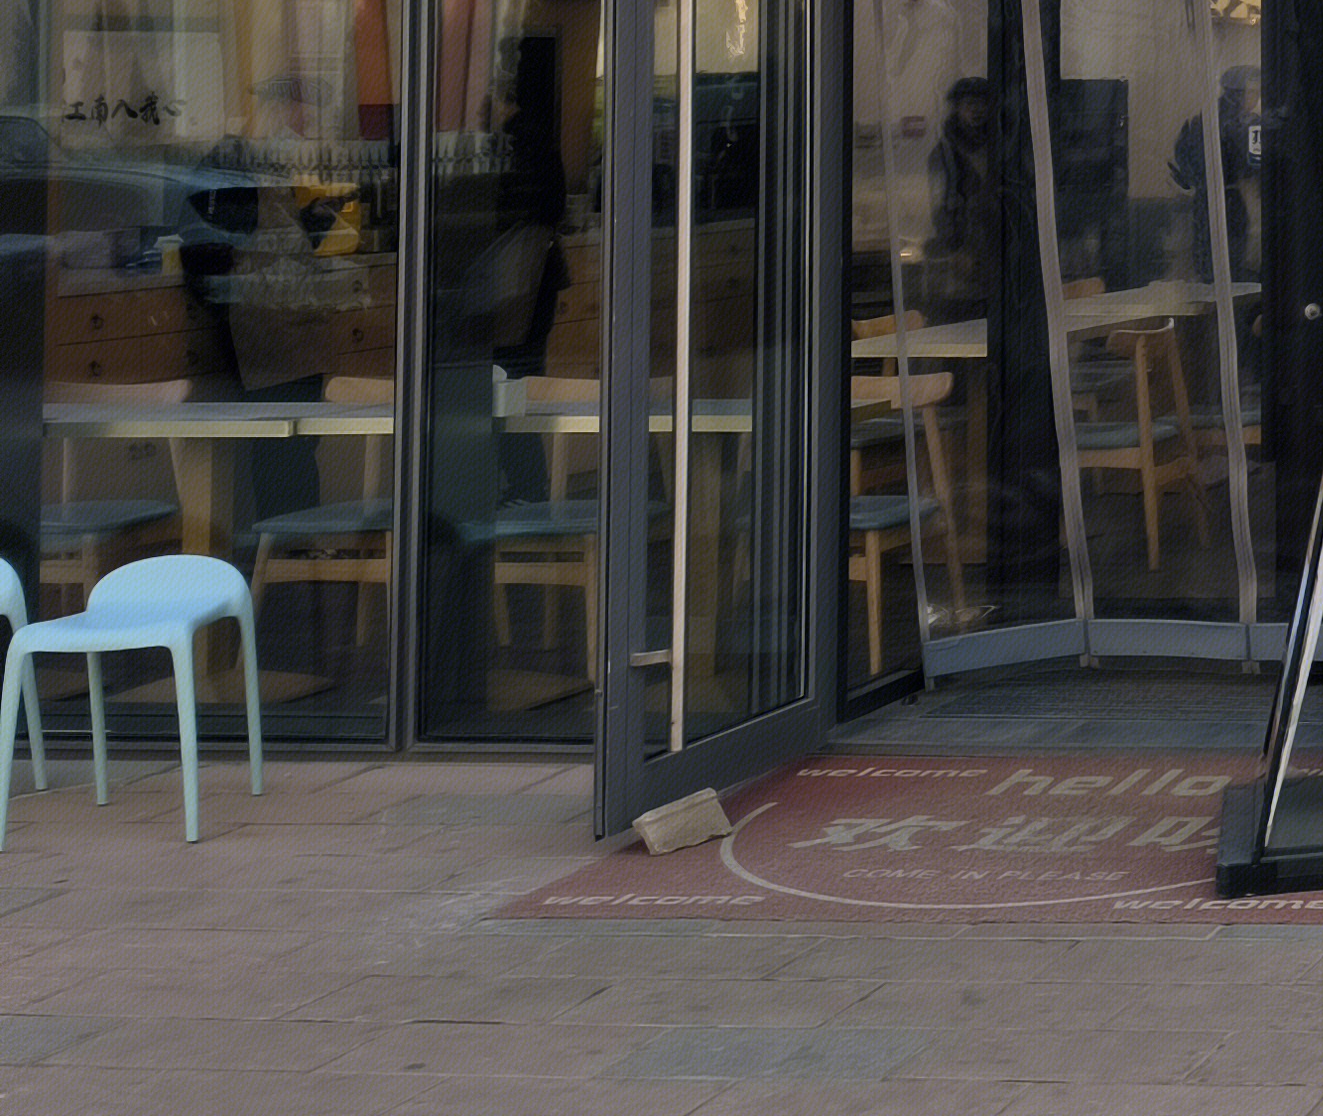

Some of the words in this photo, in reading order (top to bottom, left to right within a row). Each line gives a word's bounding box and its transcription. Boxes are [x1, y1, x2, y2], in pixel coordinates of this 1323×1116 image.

[796, 767, 989, 779] welcome
[983, 768, 1234, 797] hello
[843, 868, 944, 881] COME
[997, 871, 1131, 882] PLEASE
[543, 890, 767, 907] welcome
